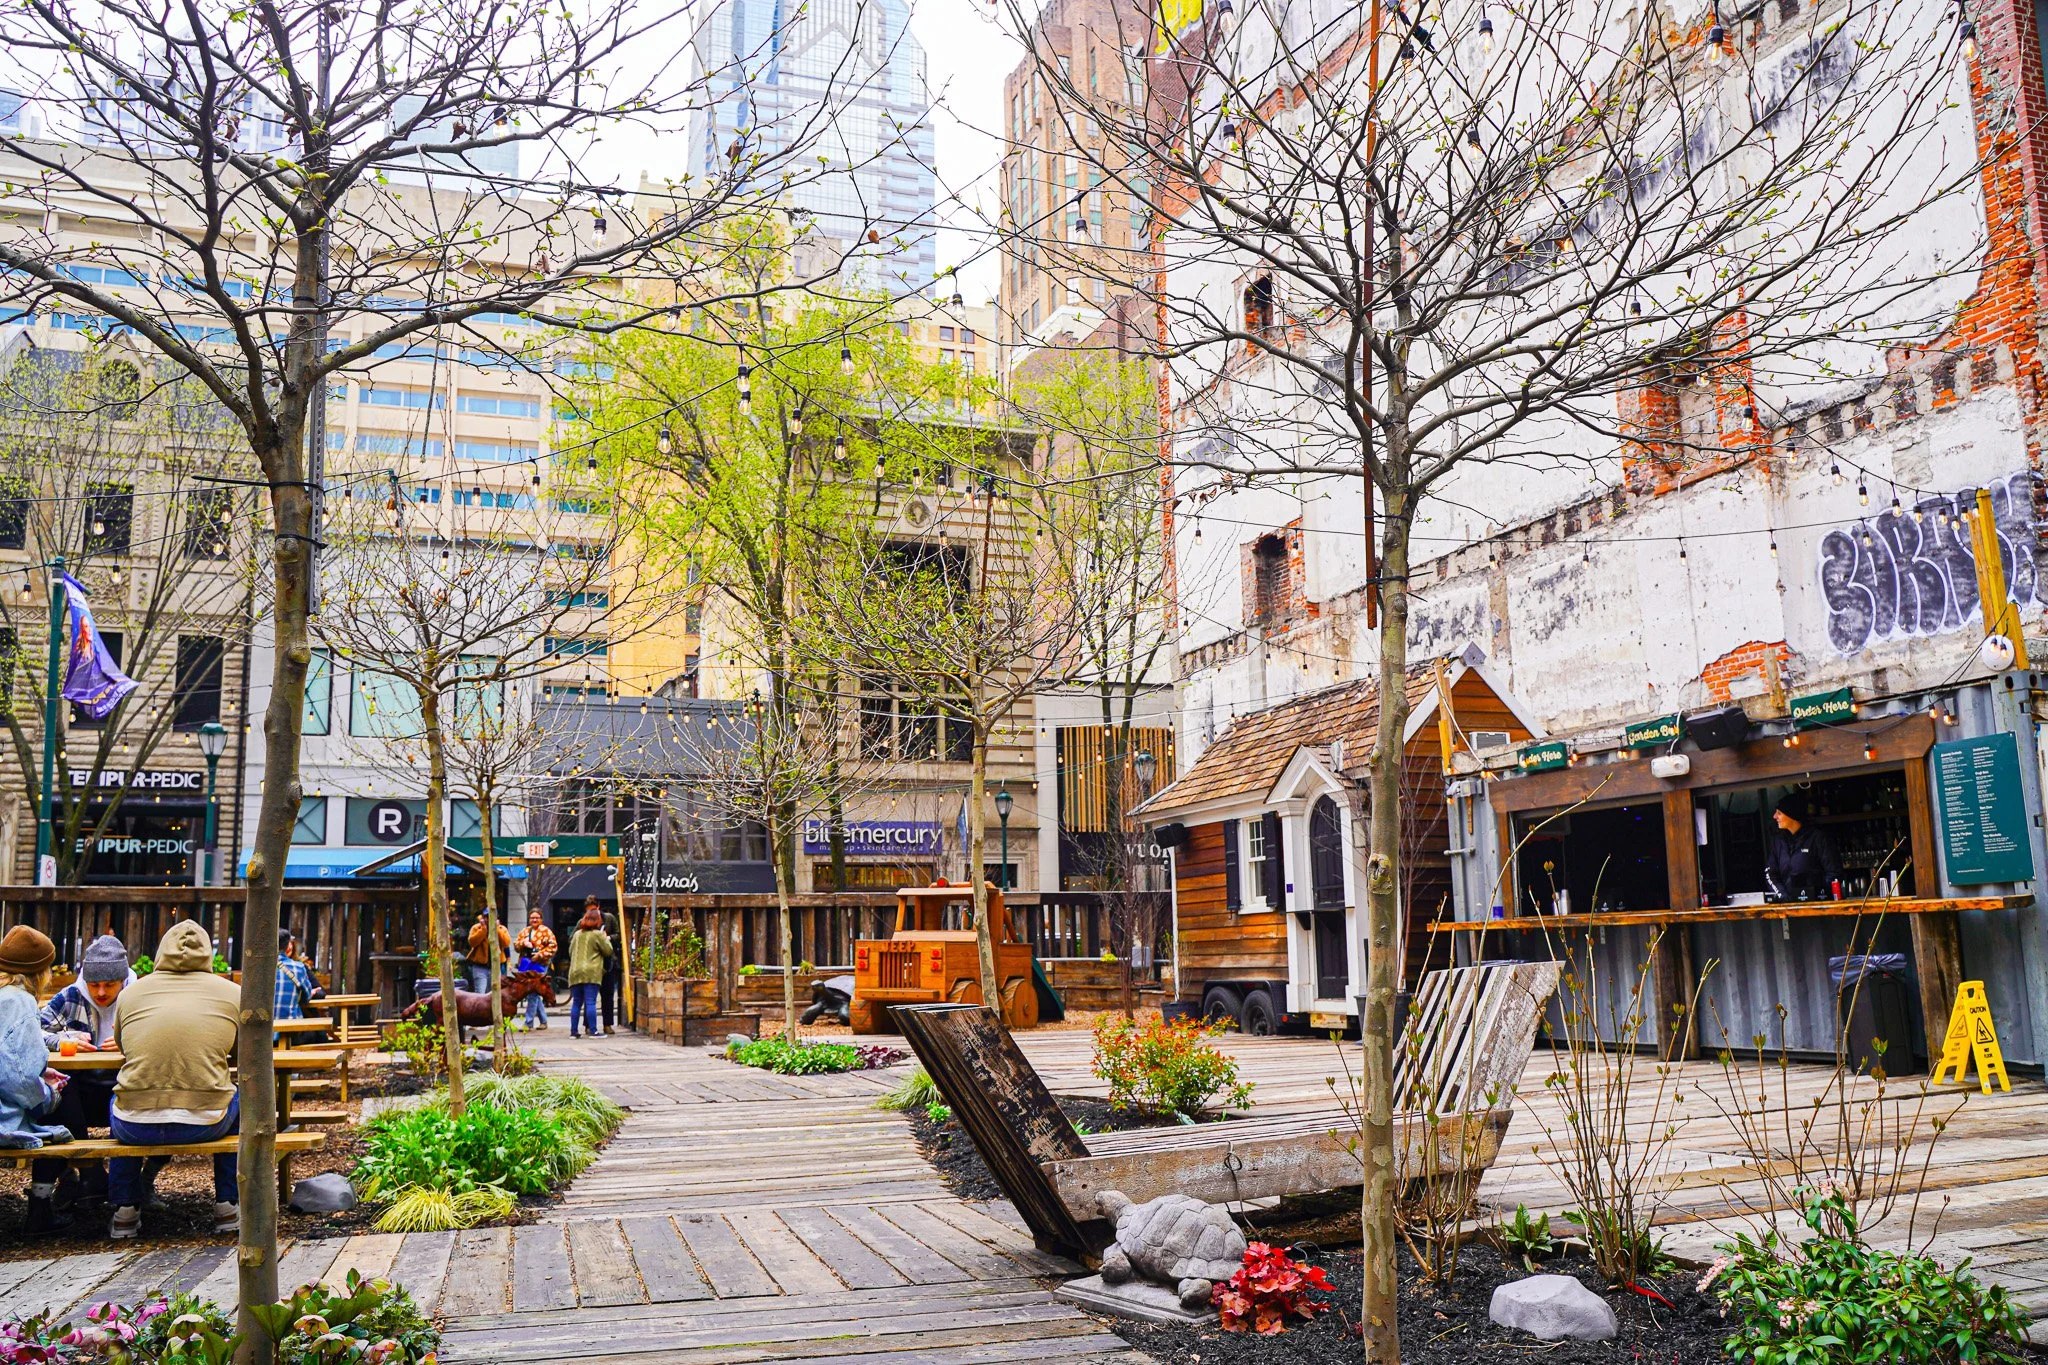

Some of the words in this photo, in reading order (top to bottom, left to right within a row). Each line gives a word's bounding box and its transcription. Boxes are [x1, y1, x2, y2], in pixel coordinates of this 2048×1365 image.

[1793, 705, 1822, 718] Order
[1822, 701, 1849, 714] Here
[1627, 729, 1659, 745] Garden
[1541, 751, 1562, 763] Here
[378, 808, 403, 834] R
[61, 838, 194, 854] EPUR-PEDIC
[529, 844, 545, 857] EXIT
[883, 941, 916, 953] JEEP
[1969, 1006, 1987, 1014] CAUTION
